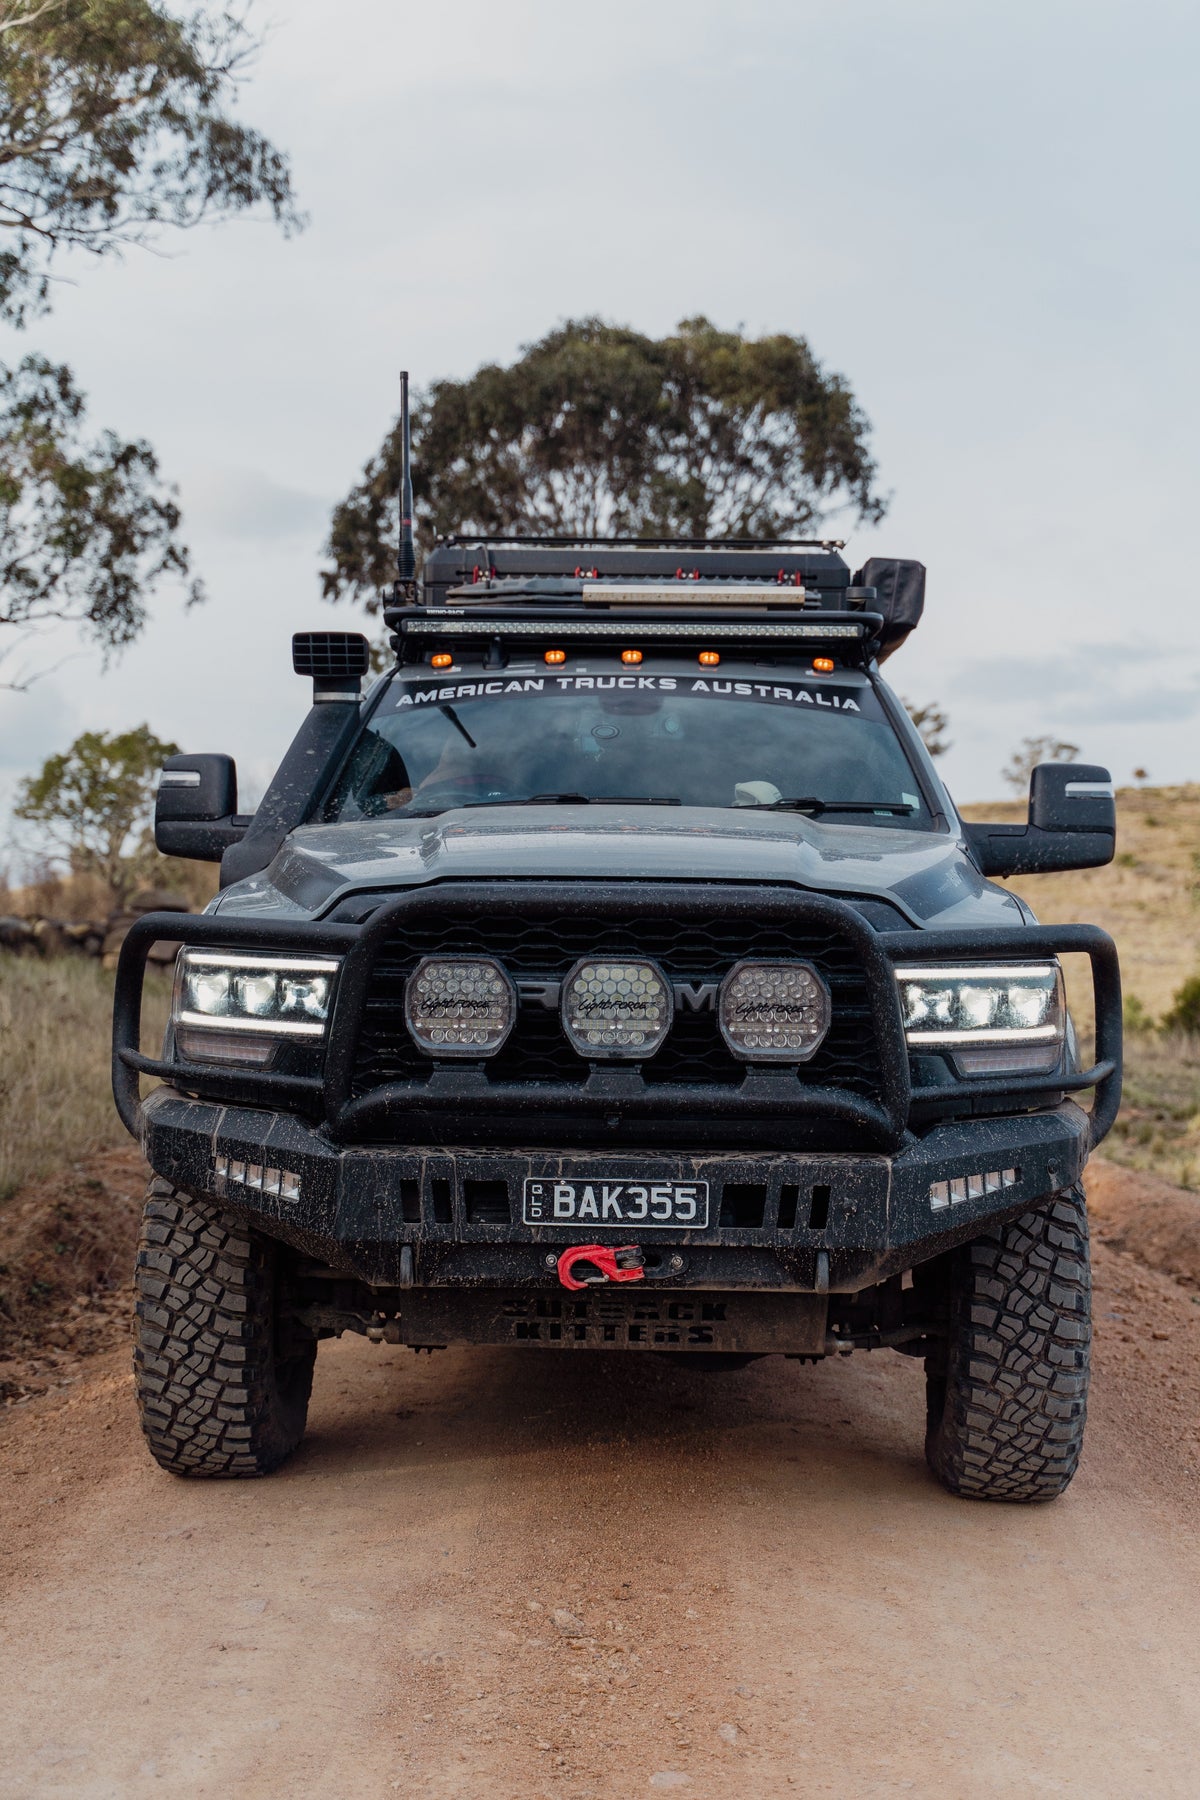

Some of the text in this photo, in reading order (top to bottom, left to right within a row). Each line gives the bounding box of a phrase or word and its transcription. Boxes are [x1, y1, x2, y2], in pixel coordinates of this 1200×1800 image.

[395, 677, 861, 712] AMERICAN TRUCKS AUSTRALIA
[516, 980, 718, 1012] RM
[531, 1184, 543, 1217] QLD
[553, 1185, 697, 1219] BAK355
